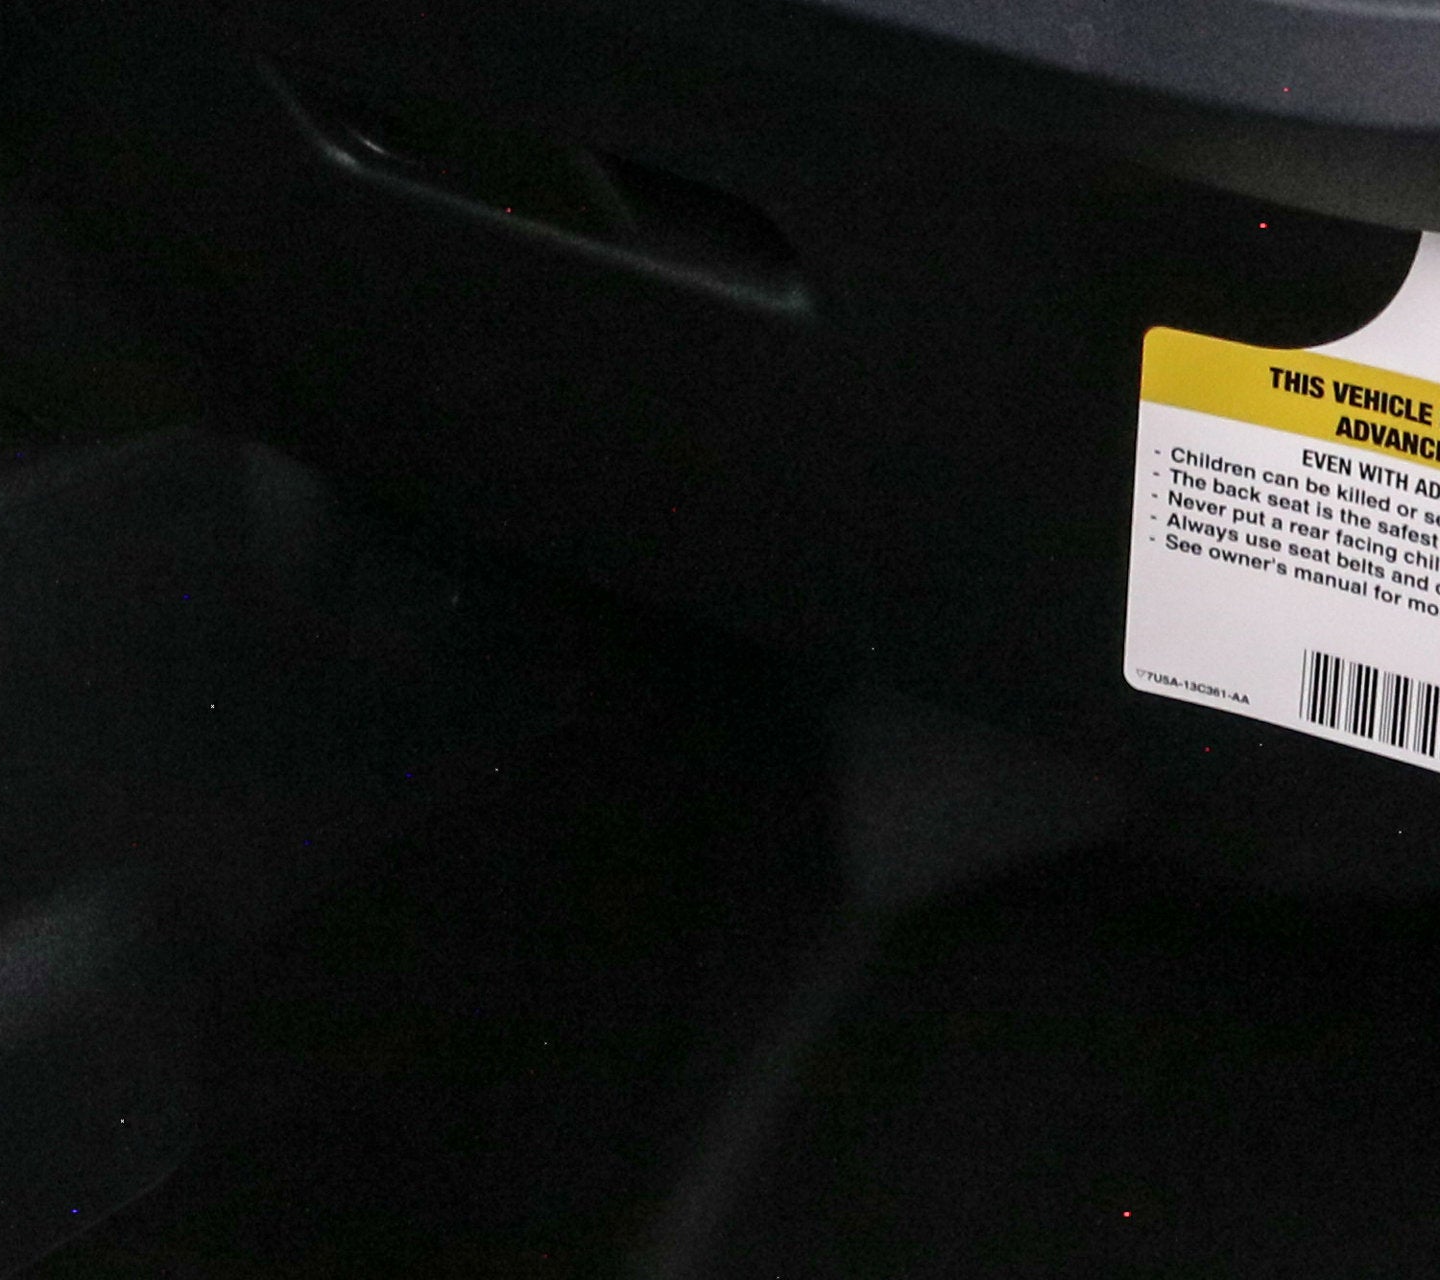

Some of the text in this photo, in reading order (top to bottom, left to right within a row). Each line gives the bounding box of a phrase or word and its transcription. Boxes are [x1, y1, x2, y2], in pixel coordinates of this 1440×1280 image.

[1270, 367, 1325, 399] THIS
[1333, 381, 1433, 426] VEHICLE
[1170, 446, 1256, 480] Children
[1263, 469, 1299, 489] can
[1305, 476, 1330, 497] be
[1337, 487, 1390, 513] killed
[1397, 502, 1419, 519] or
[1302, 448, 1352, 476] EVEN
[1359, 461, 1408, 491] WITH
[1168, 490, 1227, 516] Never
[1233, 505, 1266, 531] put
[1271, 516, 1283, 531] a
[1289, 521, 1330, 542] rear
[1335, 529, 1397, 564] facing
[1170, 468, 1207, 490] The
[1213, 479, 1261, 504] back
[1267, 493, 1310, 515] seat
[1317, 501, 1334, 519] is
[1340, 510, 1372, 530] the
[1377, 518, 1438, 550] safest
[1165, 534, 1202, 556] See
[1209, 546, 1288, 576] owner's
[1294, 564, 1368, 597] manual
[1374, 584, 1402, 606] for
[1166, 513, 1239, 543] Always
[1245, 530, 1282, 551] use
[1288, 542, 1331, 565] seat
[1336, 552, 1385, 579] belts
[1391, 568, 1430, 591] and
